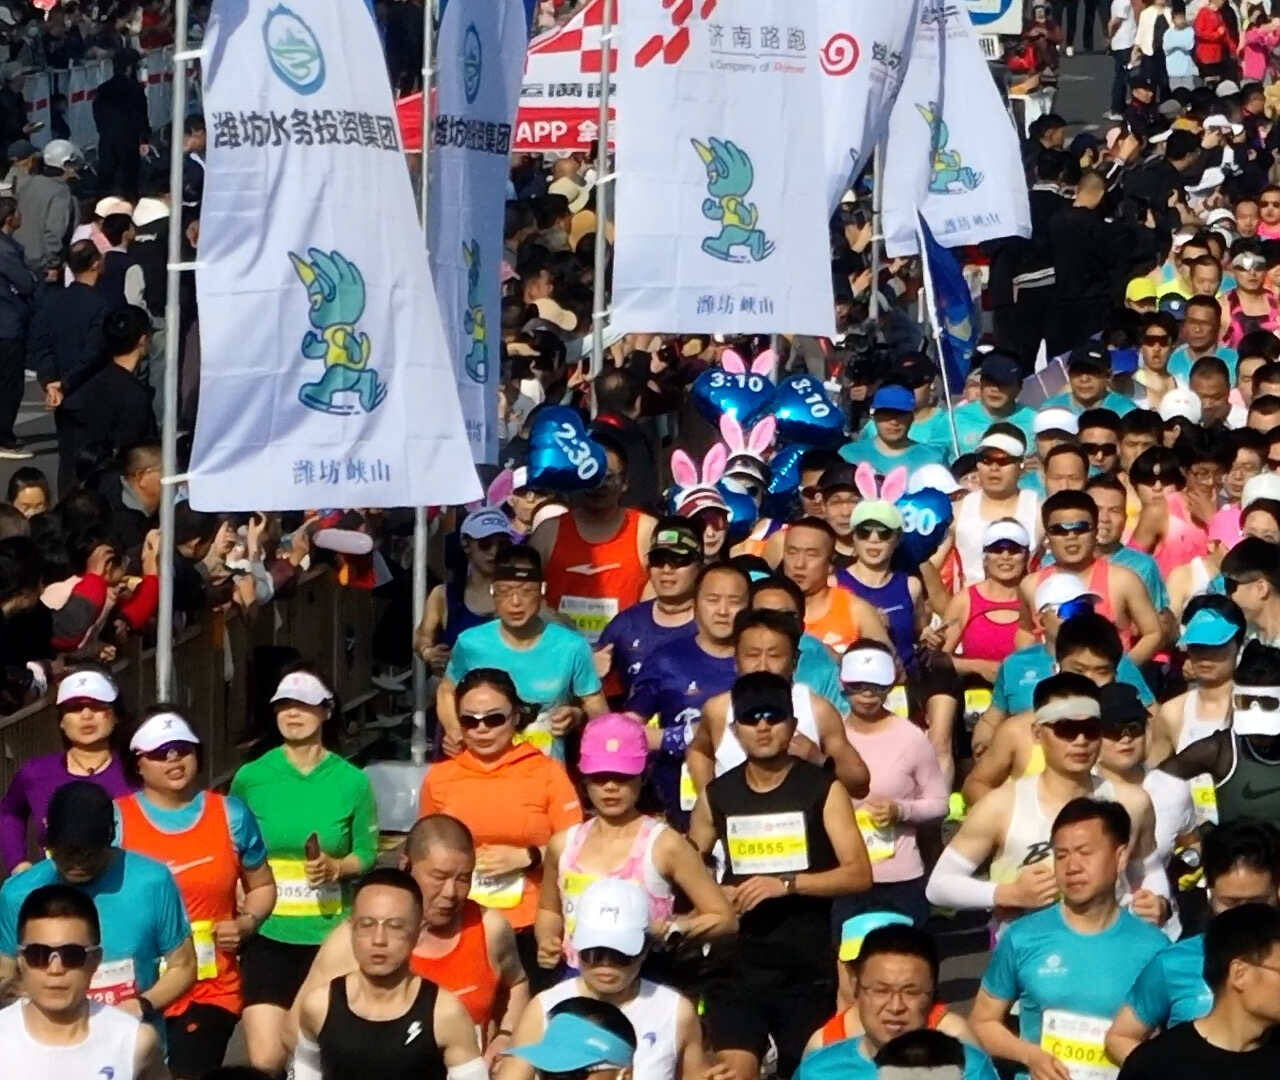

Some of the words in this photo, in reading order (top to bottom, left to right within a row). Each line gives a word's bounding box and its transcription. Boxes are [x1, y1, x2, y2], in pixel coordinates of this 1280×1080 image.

[708, 24, 806, 51] 济南路跑
[212, 108, 400, 152] 潍坊水务投资集团
[516, 120, 568, 143] APP
[696, 295, 774, 316] 潍坊峡山
[710, 373, 763, 392] 3:10
[791, 378, 830, 418] 3:10
[553, 422, 599, 480] 2:30
[293, 458, 391, 485] 潍坊峡山
